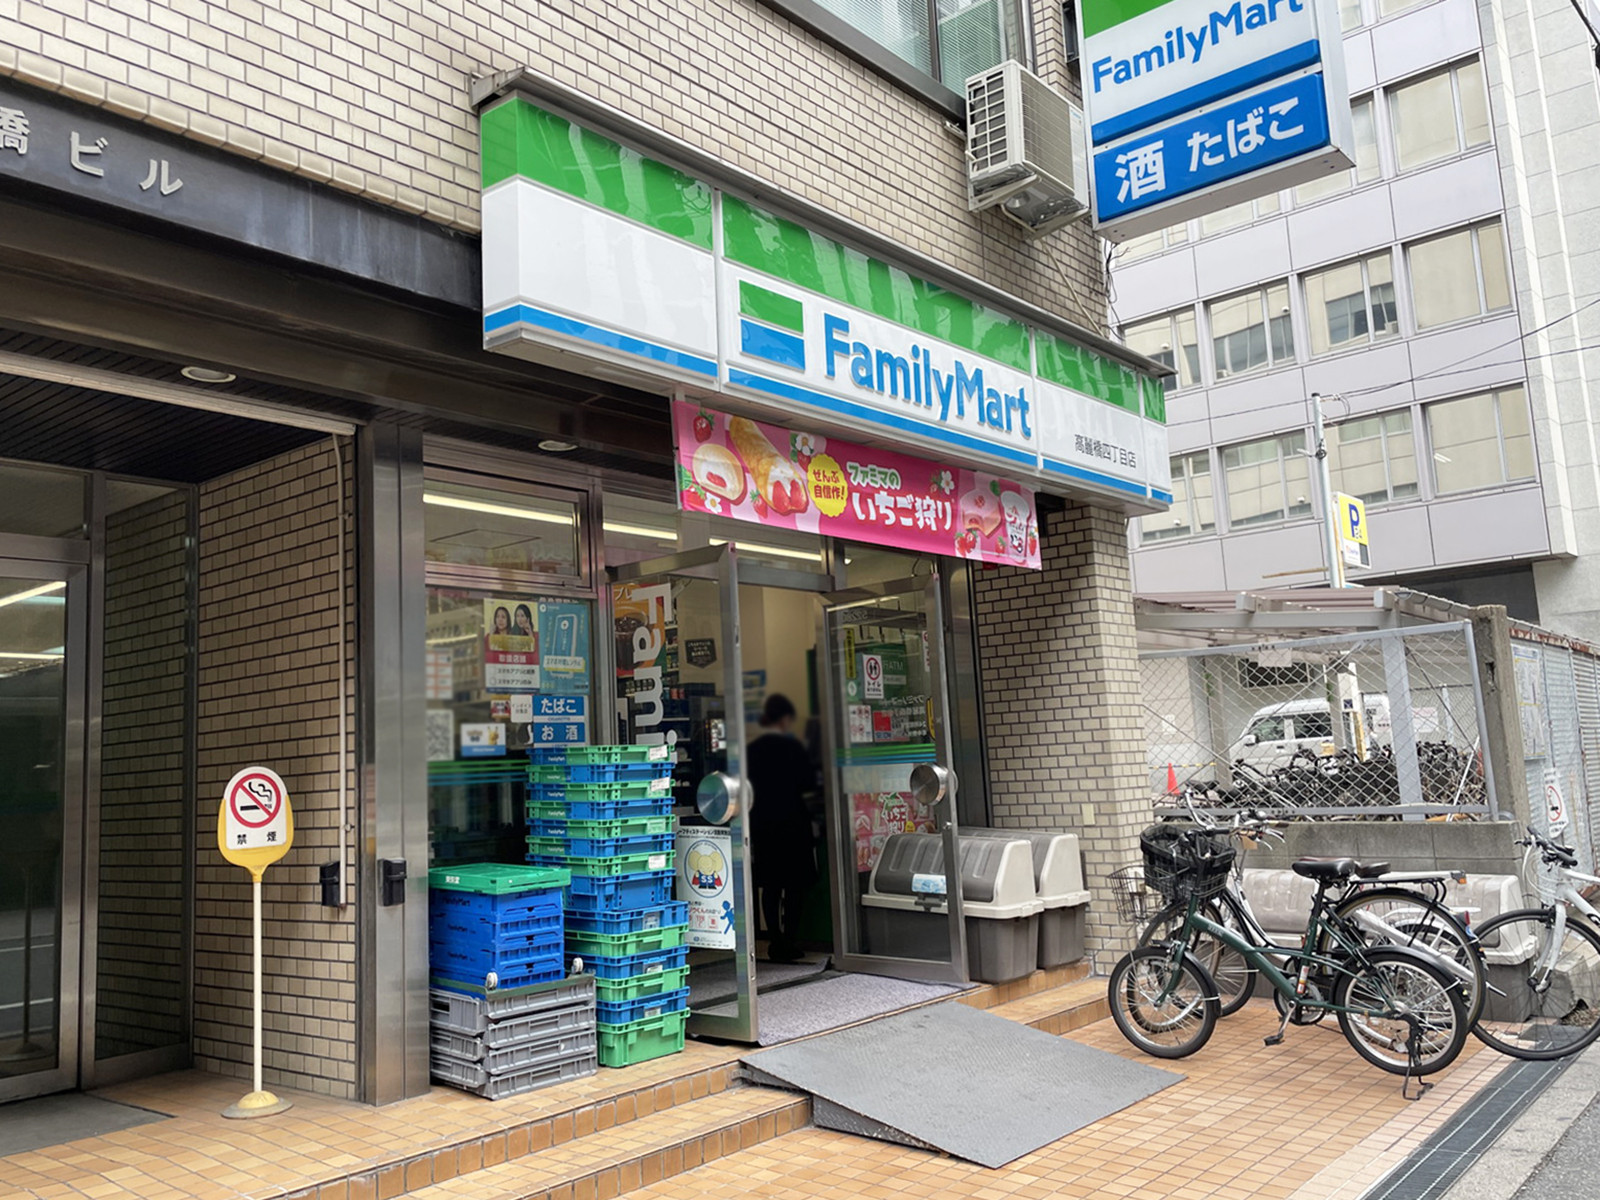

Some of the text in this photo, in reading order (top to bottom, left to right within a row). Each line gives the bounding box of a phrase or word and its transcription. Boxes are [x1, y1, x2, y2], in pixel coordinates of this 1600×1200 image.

[1115, 97, 1304, 203] 酒 たばこ
[823, 311, 1032, 440] FamilyMart
[1074, 433, 1137, 469] 高麗橋四丁目店
[846, 461, 901, 490] ファミマの
[852, 490, 952, 531] いちご狩り
[1348, 503, 1360, 538] P
[541, 698, 577, 714] たばこ
[237, 831, 277, 845] 禁煙
